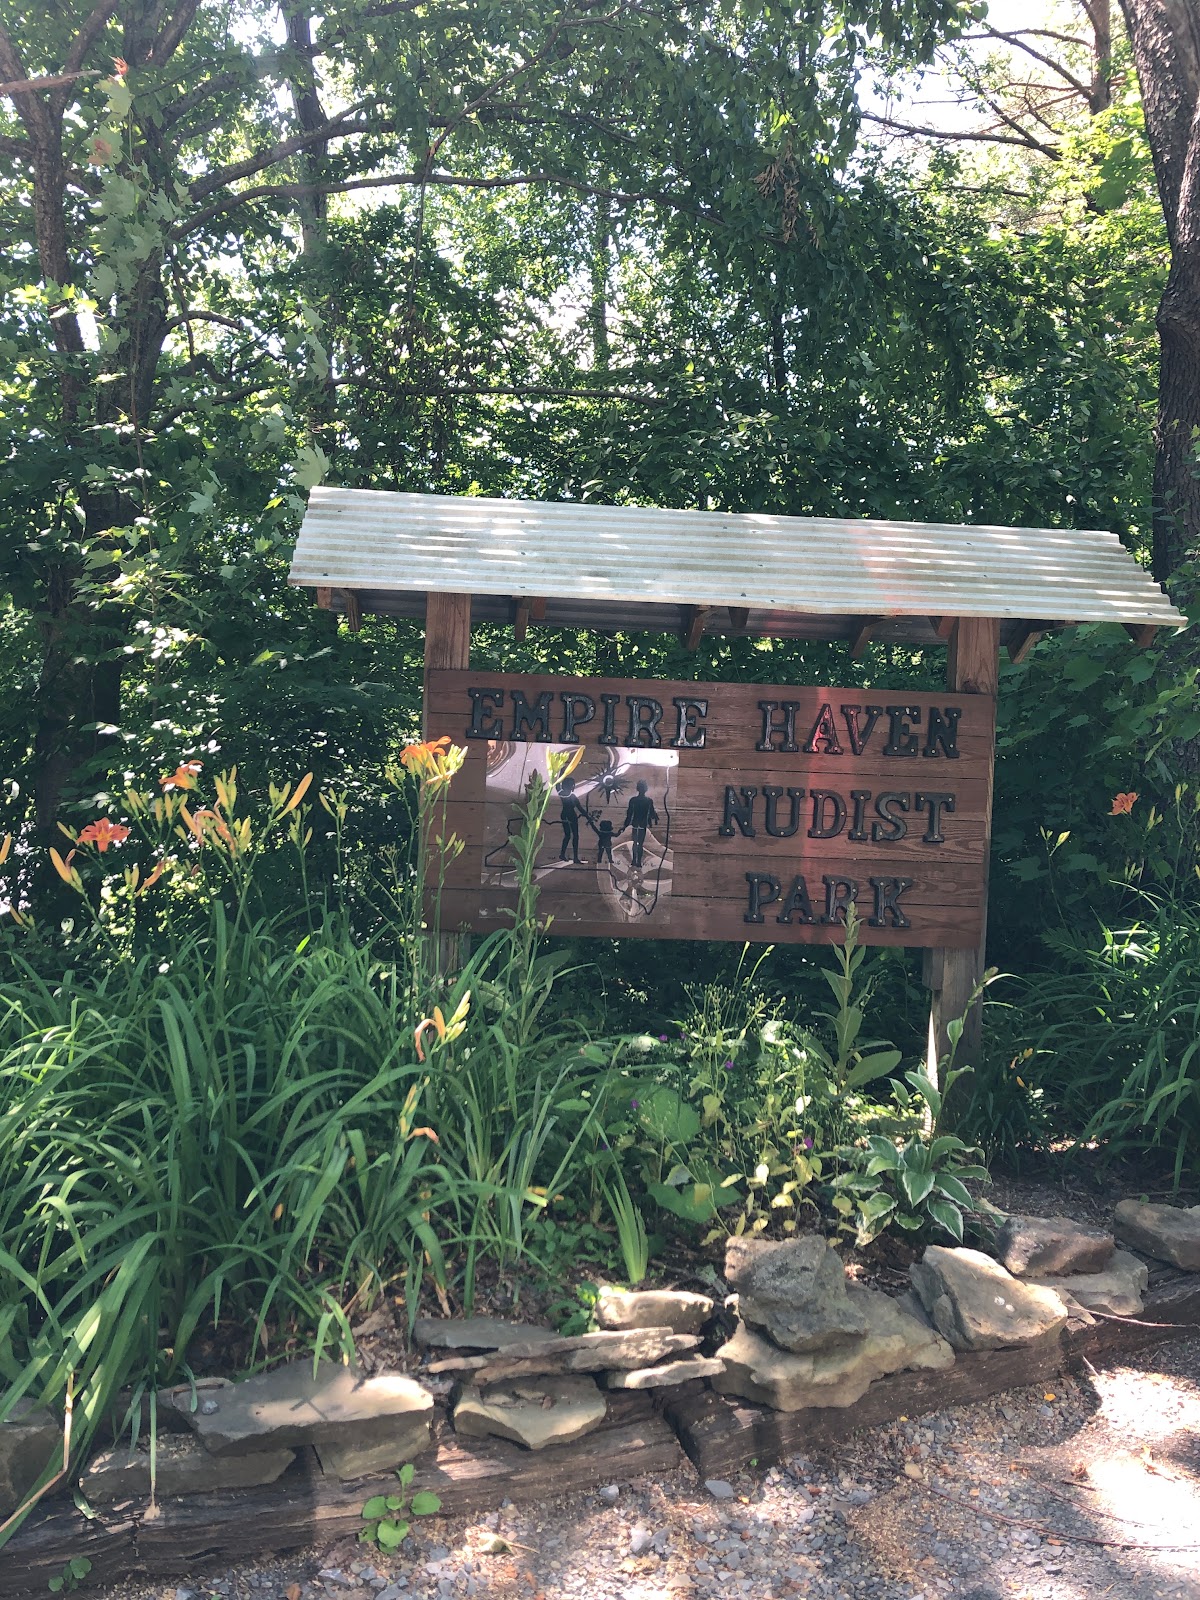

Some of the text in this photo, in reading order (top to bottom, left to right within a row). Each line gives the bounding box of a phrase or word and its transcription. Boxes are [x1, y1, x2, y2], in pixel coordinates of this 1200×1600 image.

[465, 687, 961, 758] EMPIRE HAVEN
[719, 785, 955, 842] NUDIST
[744, 871, 912, 927] PARK
